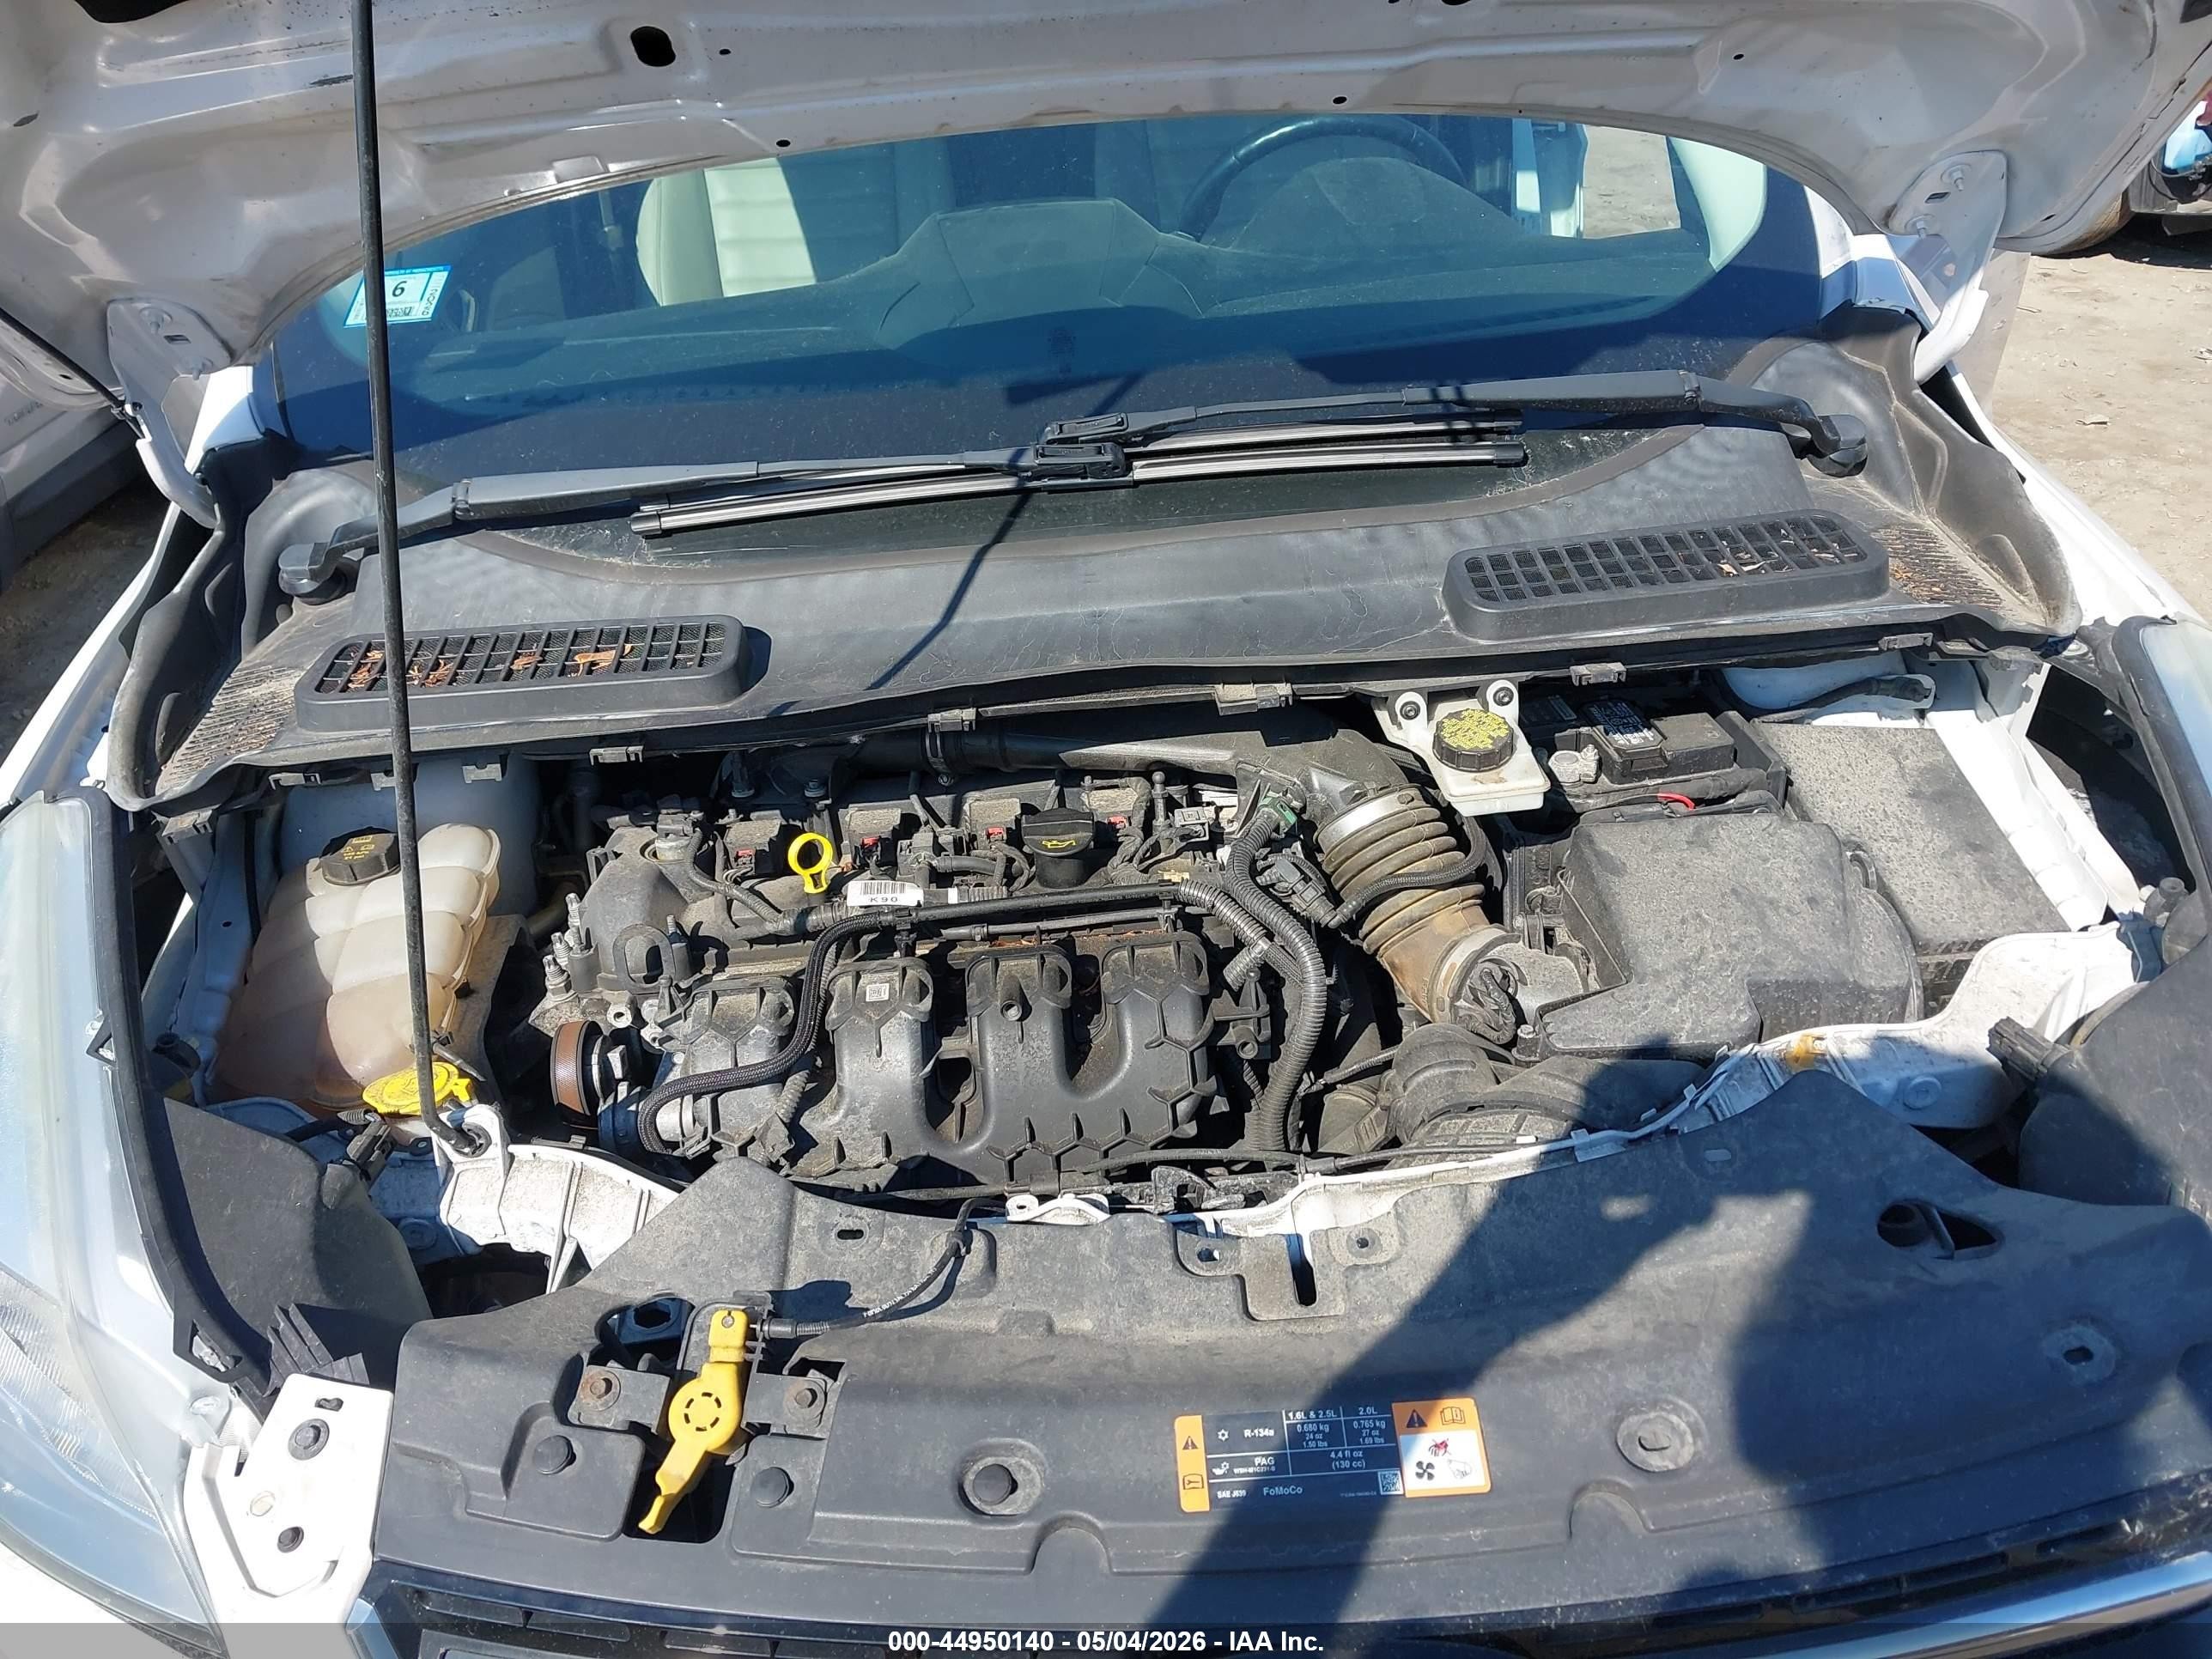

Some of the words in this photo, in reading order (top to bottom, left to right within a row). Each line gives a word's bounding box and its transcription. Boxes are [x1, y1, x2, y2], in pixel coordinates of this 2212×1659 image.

[392, 280, 407, 297] 6
[1288, 1411, 1307, 1420] 1.6L
[1358, 1407, 1377, 1415] 2.0L
[1297, 1424, 1318, 1433] 0.680
[1319, 1423, 1329, 1432] kg
[1352, 1419, 1374, 1429] 0.765
[1376, 1419, 1386, 1429] kg
[1243, 1428, 1274, 1437] R-134a
[1255, 1456, 1274, 1467] PAG
[1332, 1461, 1350, 1470] (130
[1352, 1460, 1366, 1469] cc)
[1263, 1485, 1303, 1496] FoMoCo
